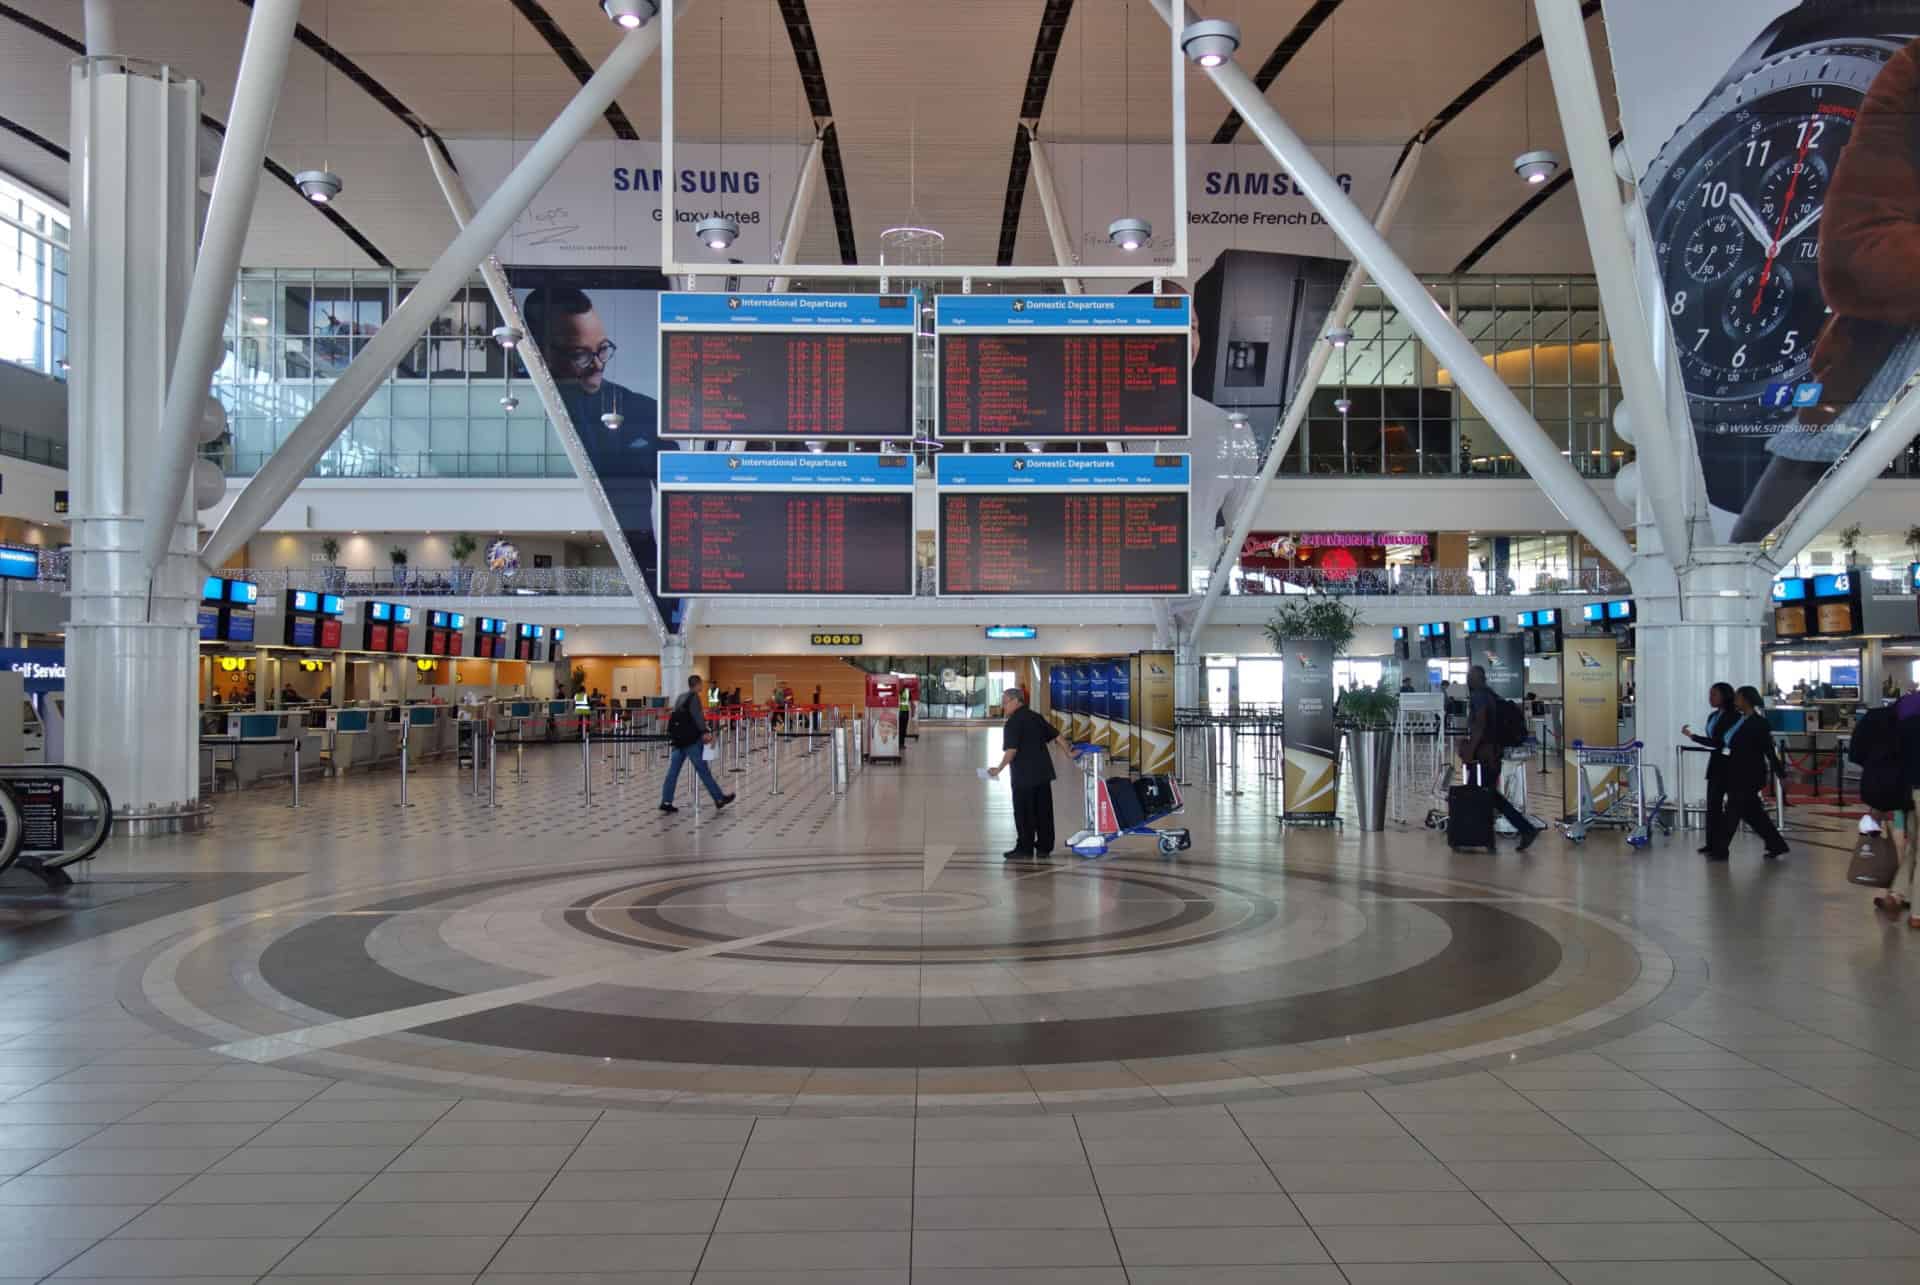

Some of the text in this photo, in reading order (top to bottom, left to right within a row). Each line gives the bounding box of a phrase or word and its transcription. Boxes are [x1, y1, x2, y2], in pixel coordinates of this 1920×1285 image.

[1797, 121, 1824, 149] 12
[1745, 140, 1772, 168] 11
[1205, 171, 1352, 195] SAMSG
[1701, 181, 1728, 208] 10
[1187, 210, 1249, 225] lexZone
[1252, 211, 1307, 225] French
[1801, 242, 1819, 258] TU
[742, 298, 848, 310] International Departures
[1026, 300, 1115, 312] Domestic Departures
[1671, 291, 1687, 315] 8
[1693, 329, 1710, 352] 7
[1781, 331, 1799, 355] 5
[1732, 344, 1747, 368] 6
[742, 457, 848, 470] International Departures
[1026, 459, 1115, 471] Domestic Departures
